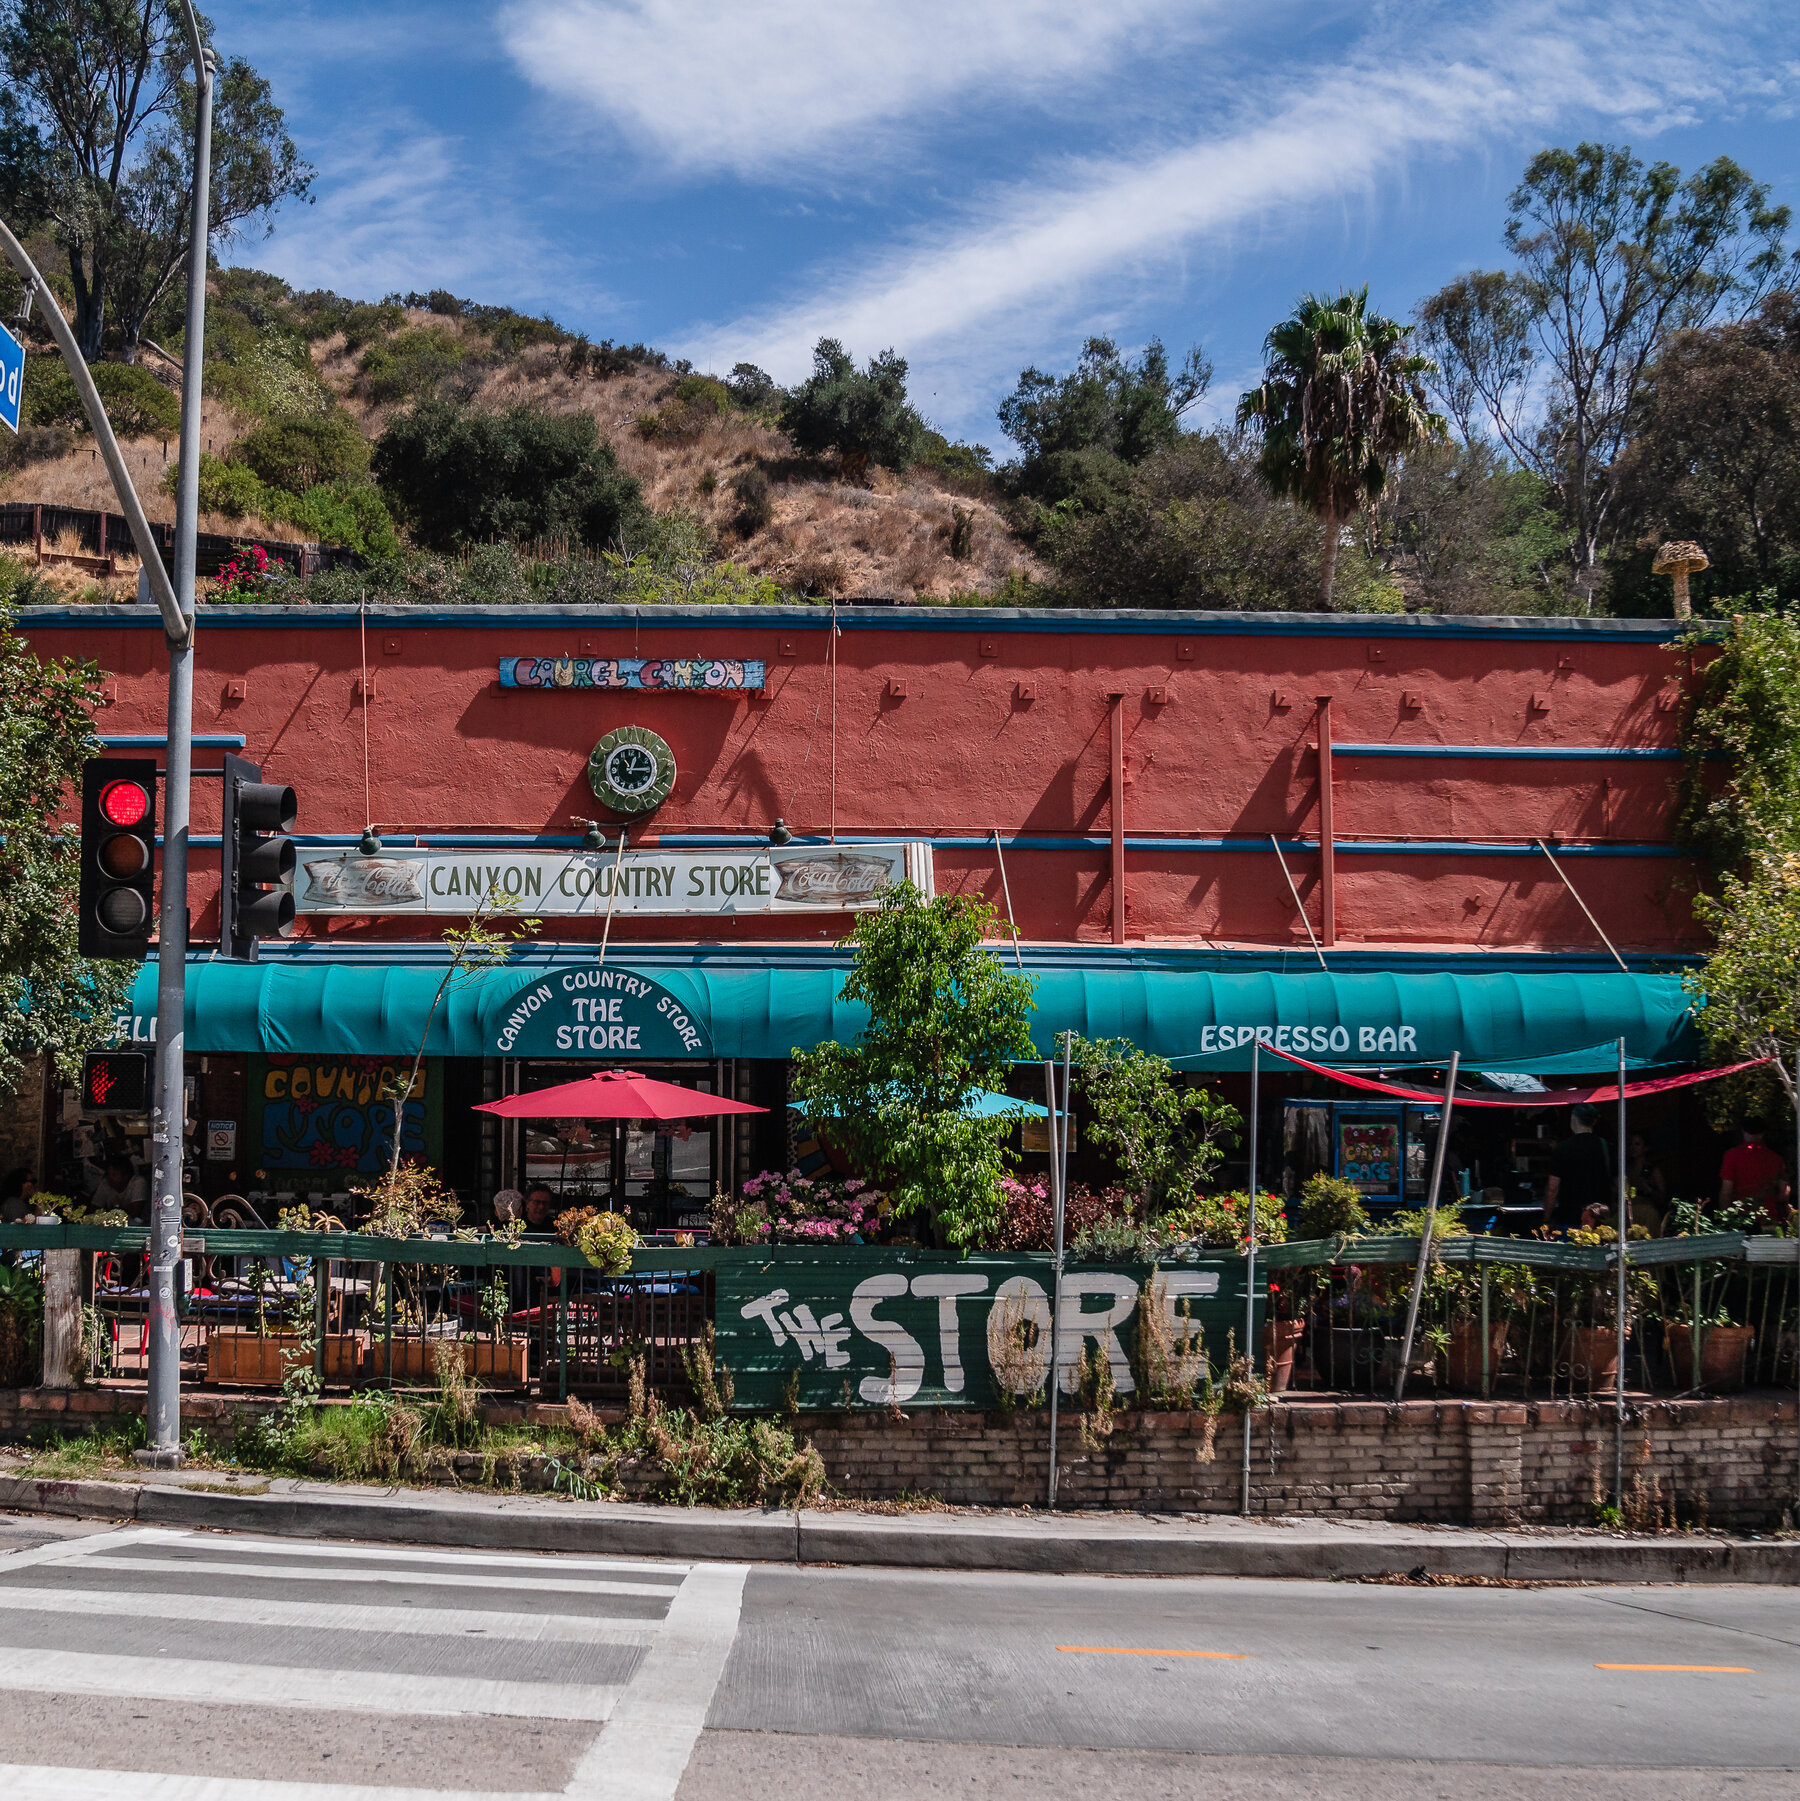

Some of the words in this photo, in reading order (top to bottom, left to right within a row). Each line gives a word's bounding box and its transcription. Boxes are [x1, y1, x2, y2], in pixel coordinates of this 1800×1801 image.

[514, 658, 628, 687] LAUREL
[639, 659, 744, 687] CANYON
[430, 866, 542, 896] CANYON
[559, 866, 676, 897] COUNTRY
[687, 865, 771, 896] STORE
[496, 984, 554, 1052] CANYON
[562, 970, 653, 999] COUNTRY
[656, 996, 703, 1052] STORE
[571, 998, 624, 1022] THE
[98, 1015, 158, 1042] ELI
[556, 1025, 641, 1050] STORE
[1201, 1025, 1350, 1052] ESPRESSO
[1358, 1025, 1417, 1052] BAR
[210, 1122, 234, 1130] NOTICE
[741, 1288, 852, 1368] THE
[849, 1272, 1220, 1403] STORE
